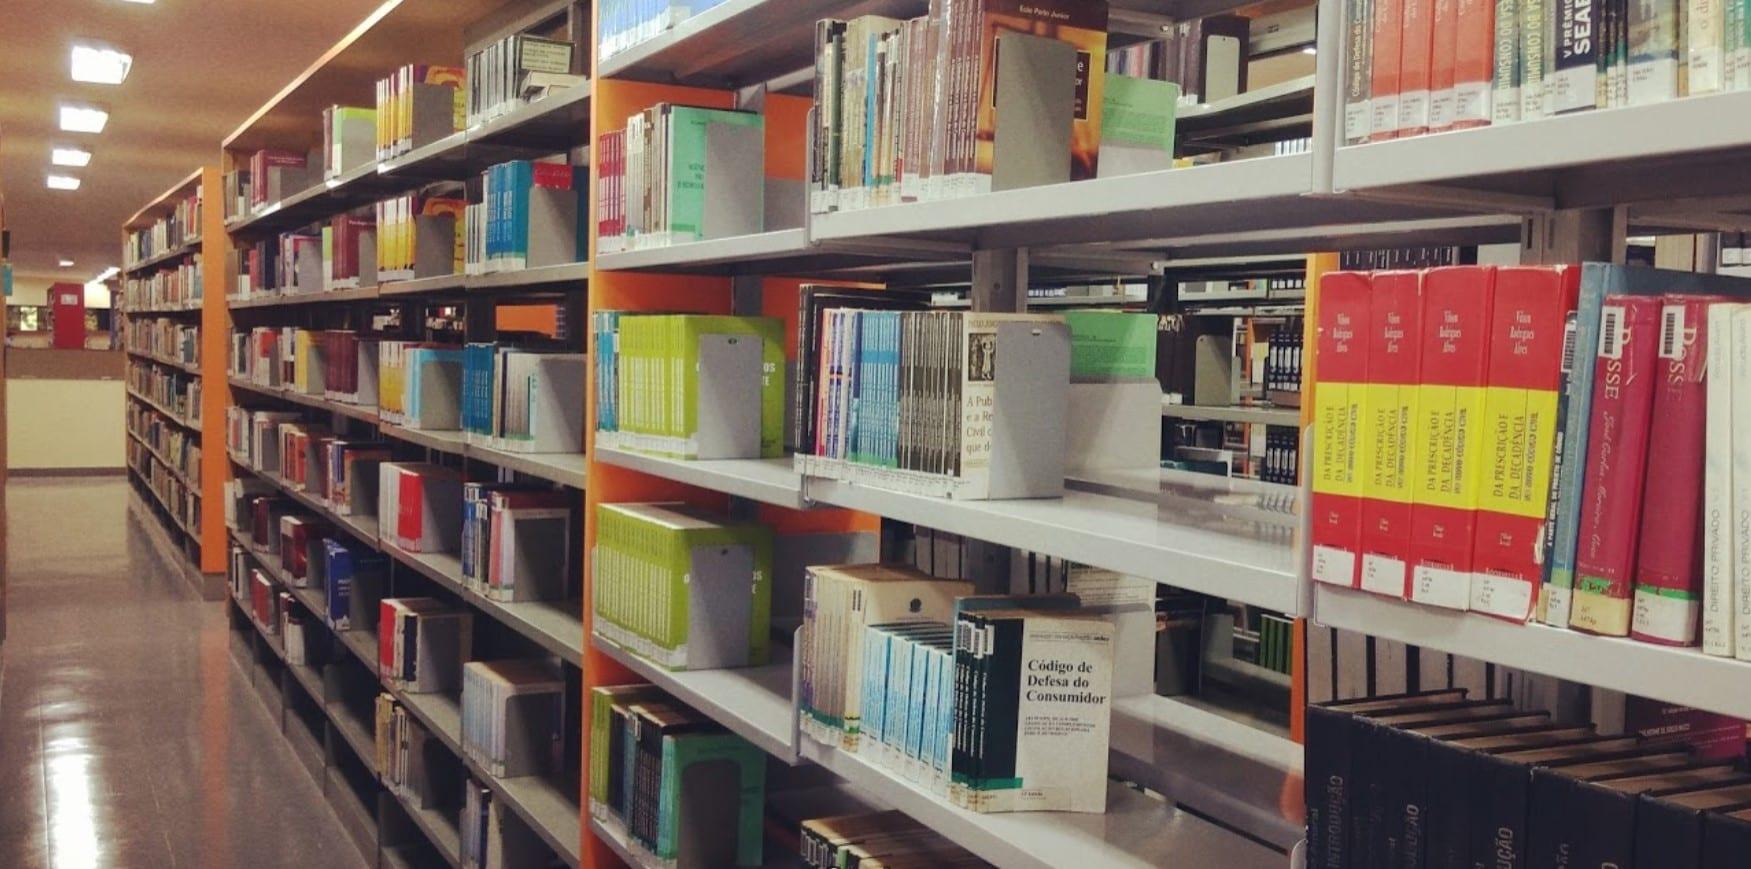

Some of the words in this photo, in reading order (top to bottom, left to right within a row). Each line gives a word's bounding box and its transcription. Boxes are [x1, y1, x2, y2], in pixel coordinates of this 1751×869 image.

[1563, 50, 1572, 58] V
[967, 397, 973, 407] A
[977, 396, 993, 406] Pub
[967, 426, 985, 437] Civil
[1324, 413, 1334, 465] PRESCRIÇÃO
[1335, 407, 1346, 463] DECADÊNCIA
[1386, 410, 1397, 468] DECADÊNCIA
[966, 444, 981, 455] que
[1376, 415, 1386, 470] PRESCRIÇÃO
[1427, 418, 1440, 475] PRESCRIÇÃO
[1441, 412, 1453, 472] DECADÊNCIA
[1510, 416, 1524, 479] DECADÊNCIA
[1494, 422, 1508, 480] PRESCRIÇÃO
[1324, 468, 1331, 480] DA
[1335, 470, 1343, 481] DA
[1376, 473, 1382, 485] DA
[1387, 475, 1394, 487] DA
[1427, 478, 1435, 490] DA
[1440, 479, 1450, 492] DA
[1493, 484, 1503, 496] DA
[1508, 486, 1520, 499] DA
[1711, 509, 1719, 563] PRIVADO
[1741, 511, 1750, 564] PRIVADO
[1710, 566, 1719, 612] DIREITO
[1741, 568, 1750, 615] DIREITO
[1028, 659, 1073, 675] Código
[1077, 661, 1093, 673] de
[1027, 675, 1069, 689] Defesa
[1073, 676, 1089, 689] do
[1026, 689, 1106, 705] Consumidor
